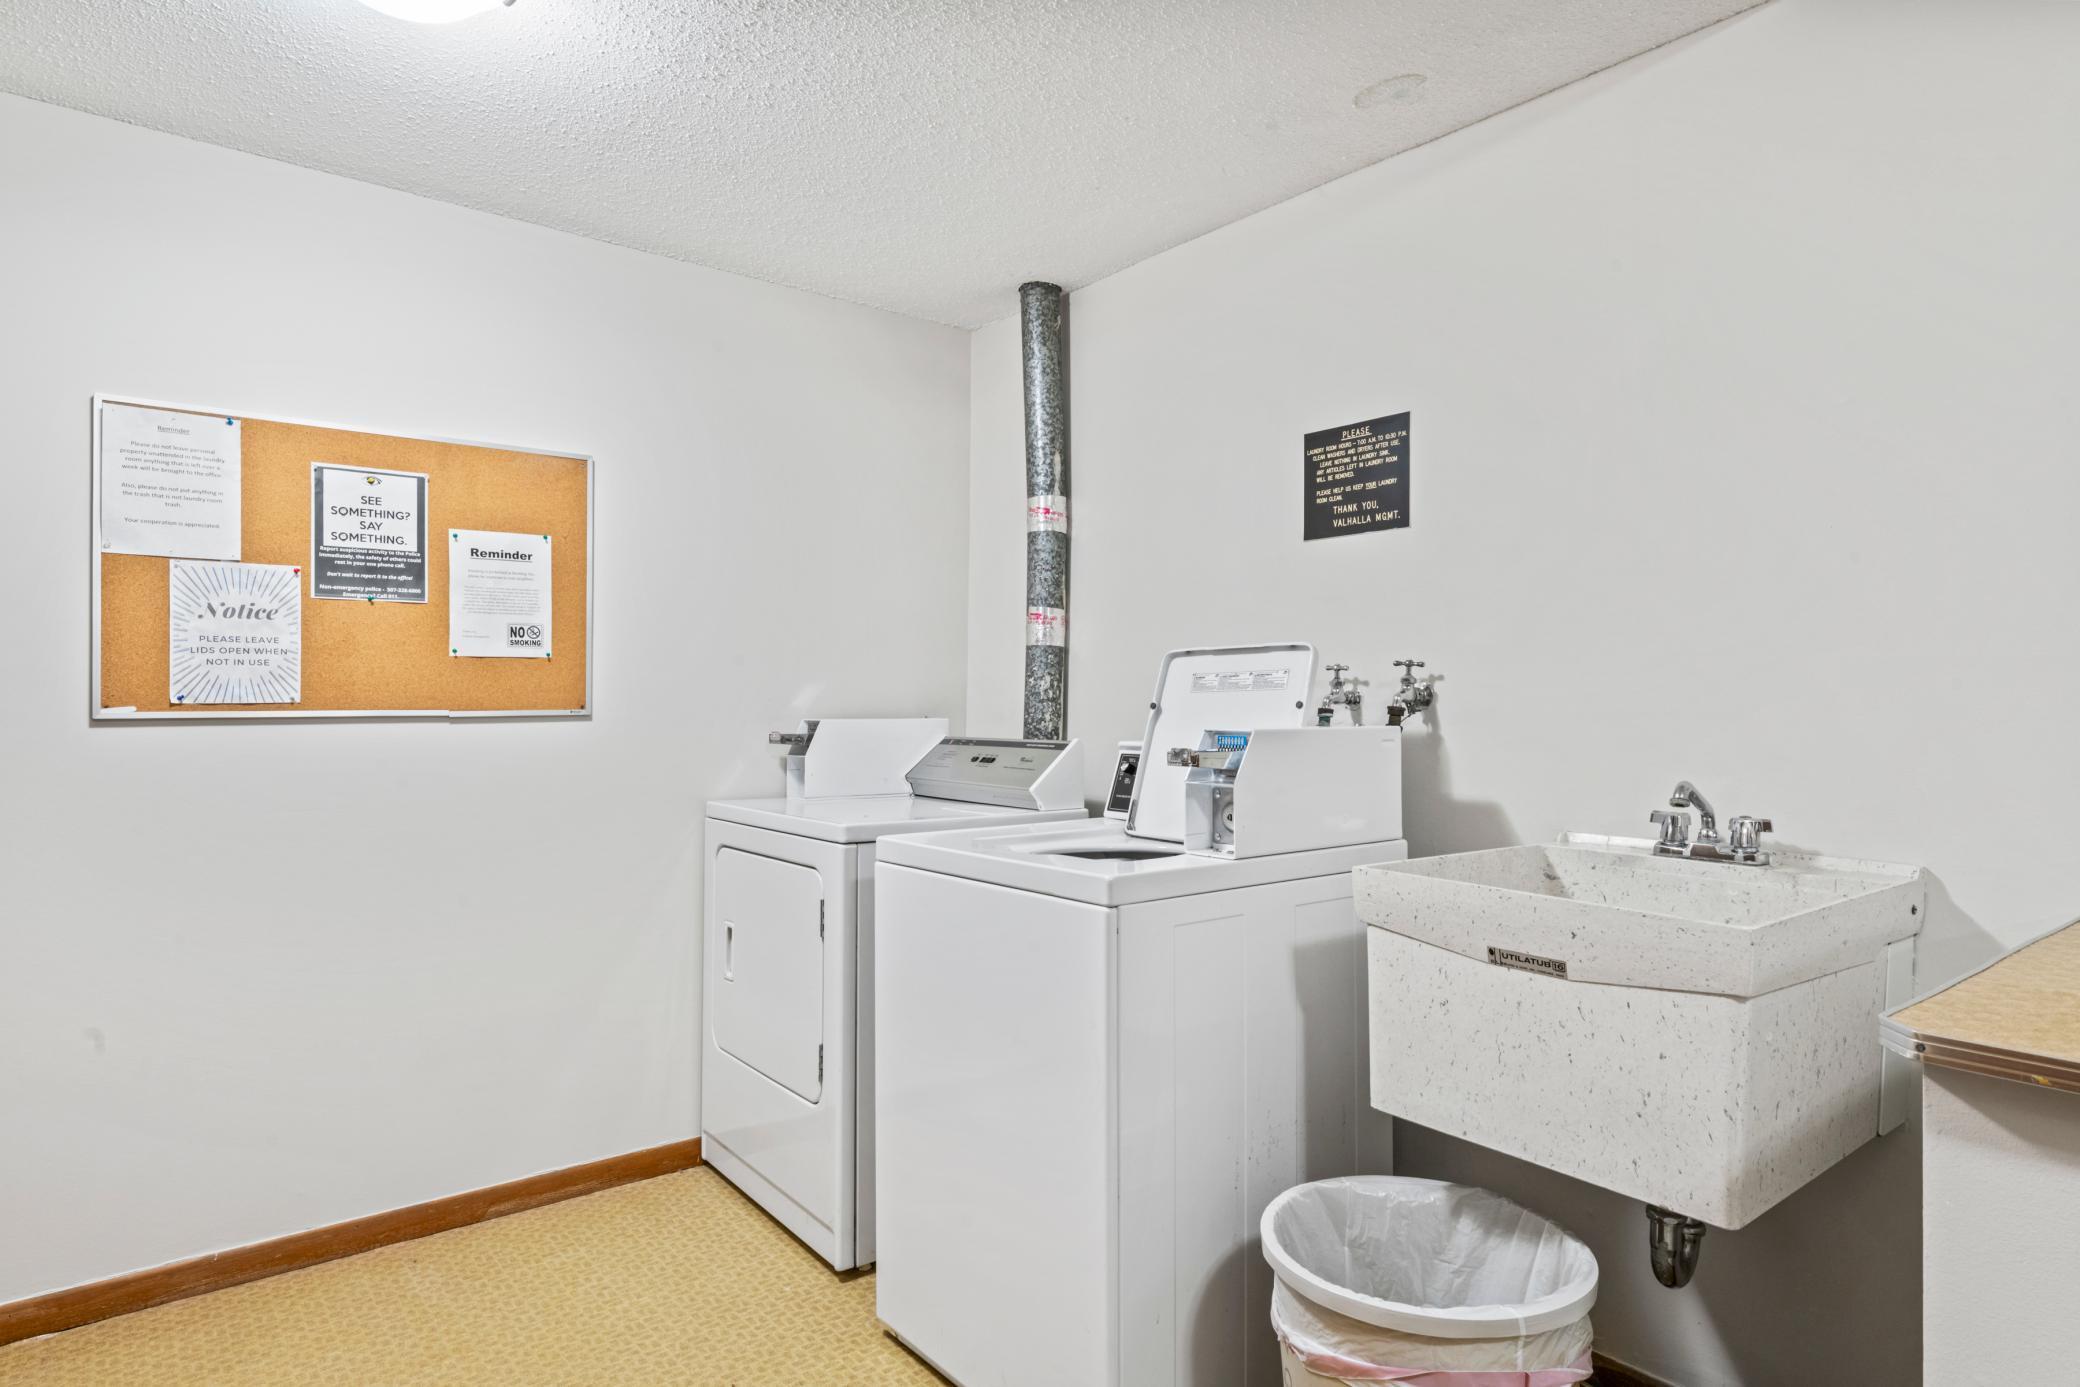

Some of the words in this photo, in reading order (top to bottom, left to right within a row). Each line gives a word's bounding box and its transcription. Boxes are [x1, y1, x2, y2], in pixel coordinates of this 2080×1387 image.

[1342, 426, 1371, 439] PLEASE
[130, 440, 150, 448] Please
[1327, 450, 1346, 459] WASHERS
[1357, 444, 1374, 453] DRYERS
[1374, 441, 1389, 449] AFTER
[1307, 447, 1325, 456] LAUNDRY
[1319, 459, 1333, 468] LEAVE
[1334, 456, 1351, 465] NOTHING
[1358, 451, 1378, 460] LAUNDRY
[161, 466, 185, 475] brought
[193, 469, 204, 477] the
[1325, 465, 1345, 474] ARTICLES
[1365, 458, 1384, 467] LAUNDRY
[137, 483, 158, 491] please
[191, 488, 217, 497] anything
[1316, 488, 1331, 496] PLEASE
[1332, 486, 1344, 494] HELP
[1365, 481, 1377, 489] YOUR
[1378, 477, 1397, 487] LAUNDRY
[183, 494, 206, 503] laundry
[360, 495, 382, 506] SEE
[1316, 496, 1328, 504] ROOM
[330, 505, 411, 521] SOMETHING?
[1332, 503, 1358, 515] THANK
[1361, 500, 1379, 510] YOU.
[1332, 514, 1371, 528] VALHALLA
[1375, 510, 1401, 522] MGMT.
[359, 520, 383, 531] SAY
[330, 531, 408, 546] SOMETHING.
[319, 545, 339, 553] Report
[339, 547, 368, 555] suspicious
[470, 547, 533, 561] Reminder
[198, 602, 279, 620] Notice
[510, 626, 525, 638] NO
[199, 635, 241, 643] PLEASE
[245, 636, 279, 644] LEAVE
[509, 639, 541, 647] SMOKING
[219, 647, 250, 655] OPEN
[206, 658, 229, 666] NOT
[1501, 952, 1552, 968] UTILATUB
